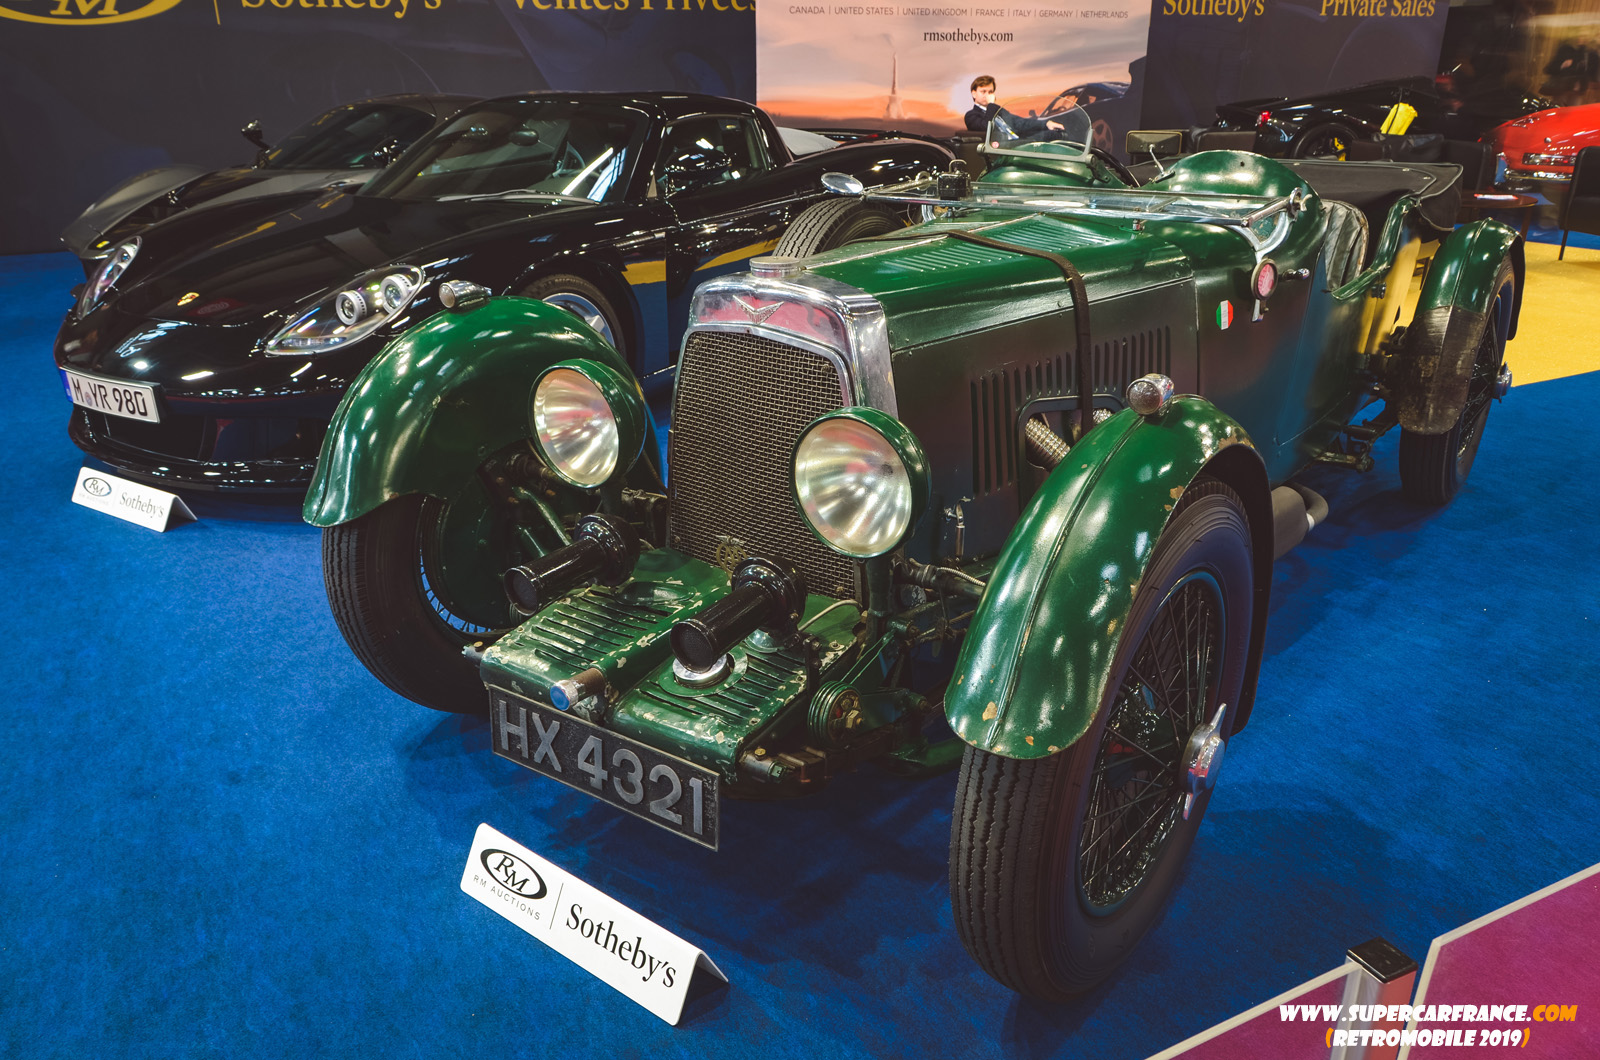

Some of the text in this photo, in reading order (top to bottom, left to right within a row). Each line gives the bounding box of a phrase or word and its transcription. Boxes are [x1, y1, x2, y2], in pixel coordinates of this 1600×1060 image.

[788, 5, 1129, 19] CANADA UNITED STATES UNITED KINGDOM FRANCE ITALY GERMANY NETHERLANDS
[1390, 0, 1436, 17] Sales
[923, 28, 1014, 45] rmsothebys.com
[71, 377, 148, 417] M YR 980
[119, 492, 165, 519] Sotheby's
[499, 700, 703, 836] HX 4321
[493, 854, 530, 893] RM
[472, 874, 541, 921] RM AUCTIONS
[565, 903, 677, 989] Sotheby's
